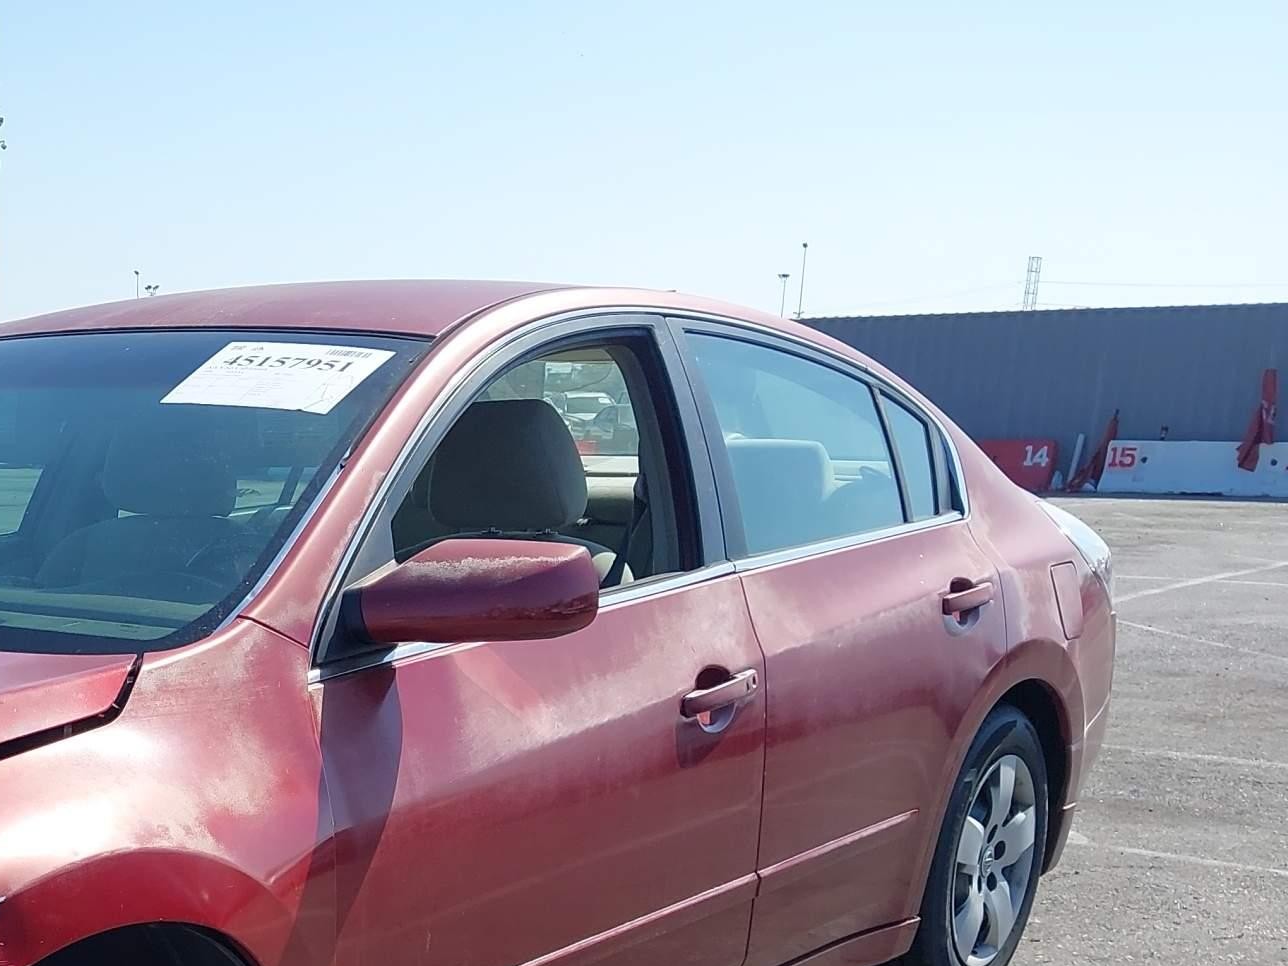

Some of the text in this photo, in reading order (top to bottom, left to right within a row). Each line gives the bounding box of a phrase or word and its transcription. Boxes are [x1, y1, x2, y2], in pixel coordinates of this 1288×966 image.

[223, 354, 354, 373] 45157951
[1023, 445, 1050, 467] 14
[1108, 446, 1138, 468] 15
